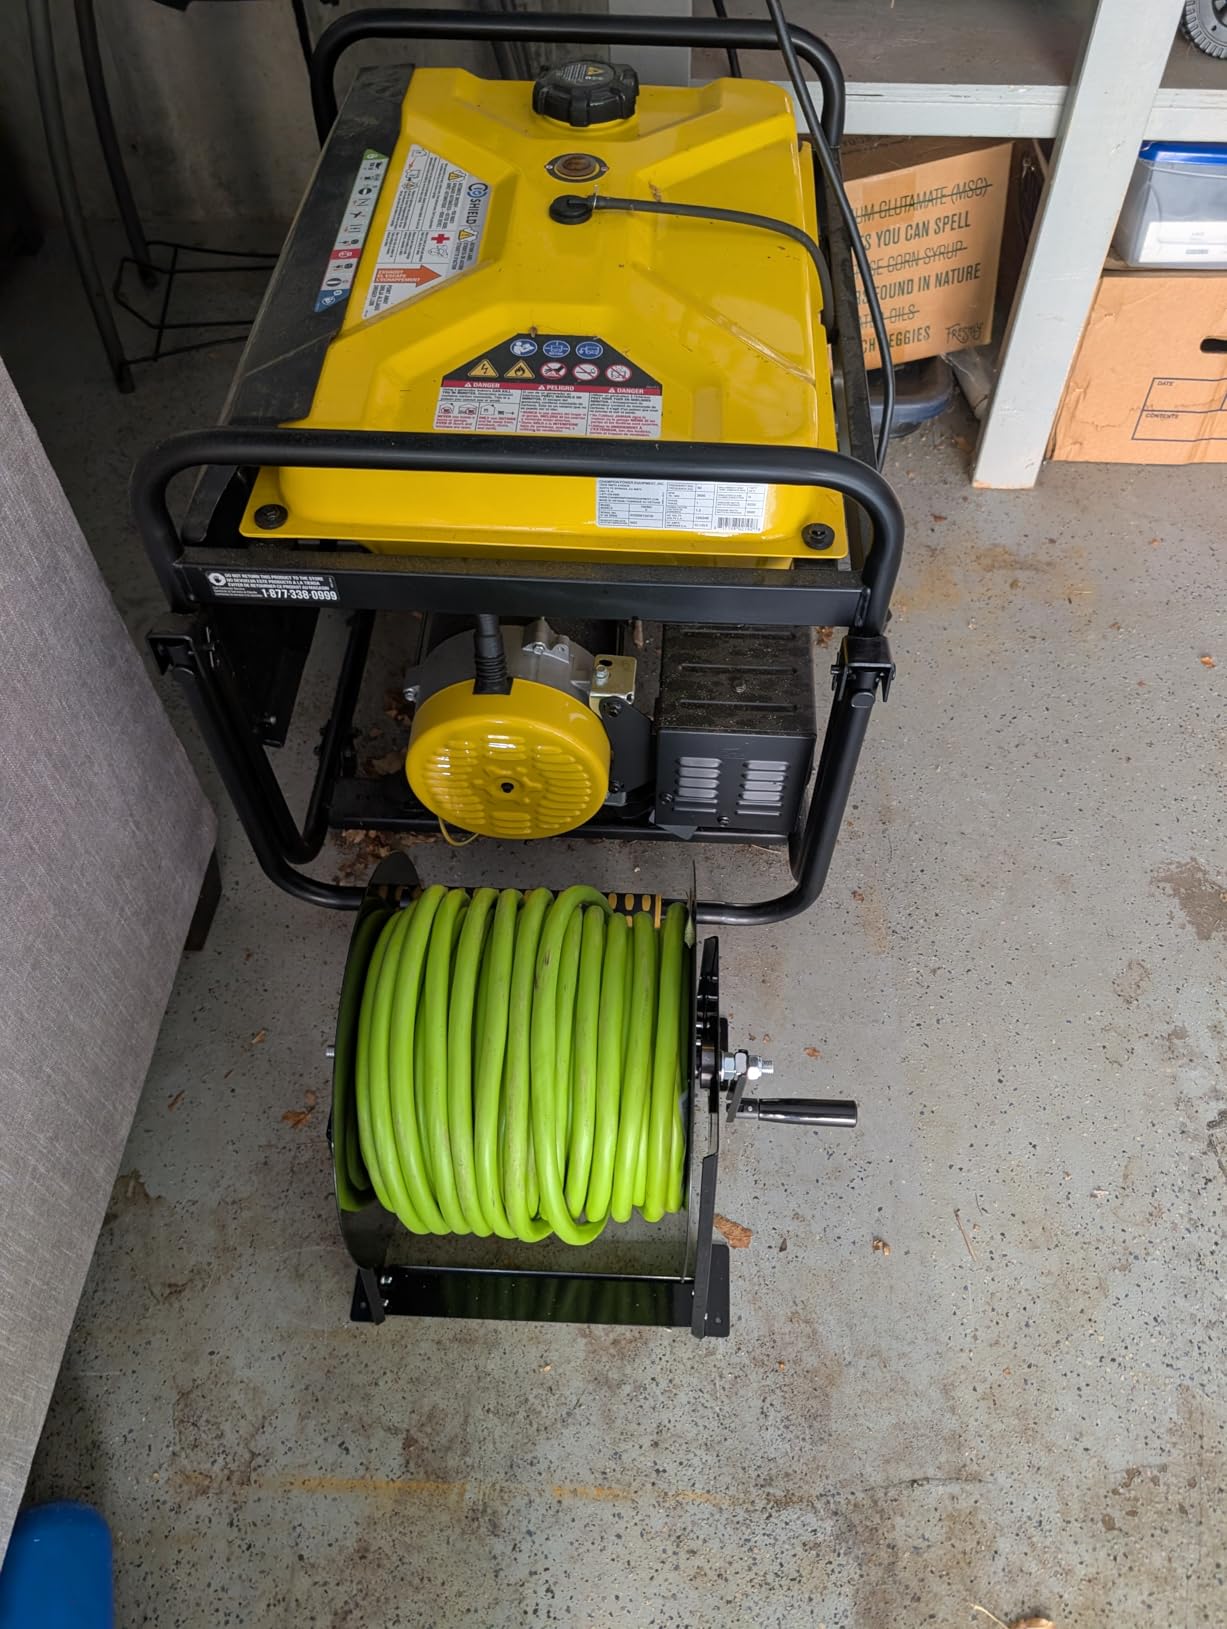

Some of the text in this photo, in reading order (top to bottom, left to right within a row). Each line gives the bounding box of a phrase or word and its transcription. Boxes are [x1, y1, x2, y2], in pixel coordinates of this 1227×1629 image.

[466, 198, 482, 224] SHIELD
[879, 186, 948, 219] GLUTAMATE
[951, 177, 989, 205] (MSG)
[876, 227, 900, 248] YOU
[905, 220, 930, 241] CAN
[934, 210, 971, 234] SPELL
[887, 251, 920, 272] CORN
[923, 240, 965, 264] SYRUP
[918, 275, 931, 293] IN
[935, 263, 982, 288] NATURE
[889, 304, 917, 323] OILS
[889, 326, 931, 349] EGGIES
[261, 588, 337, 601] 1-877-338-0999
